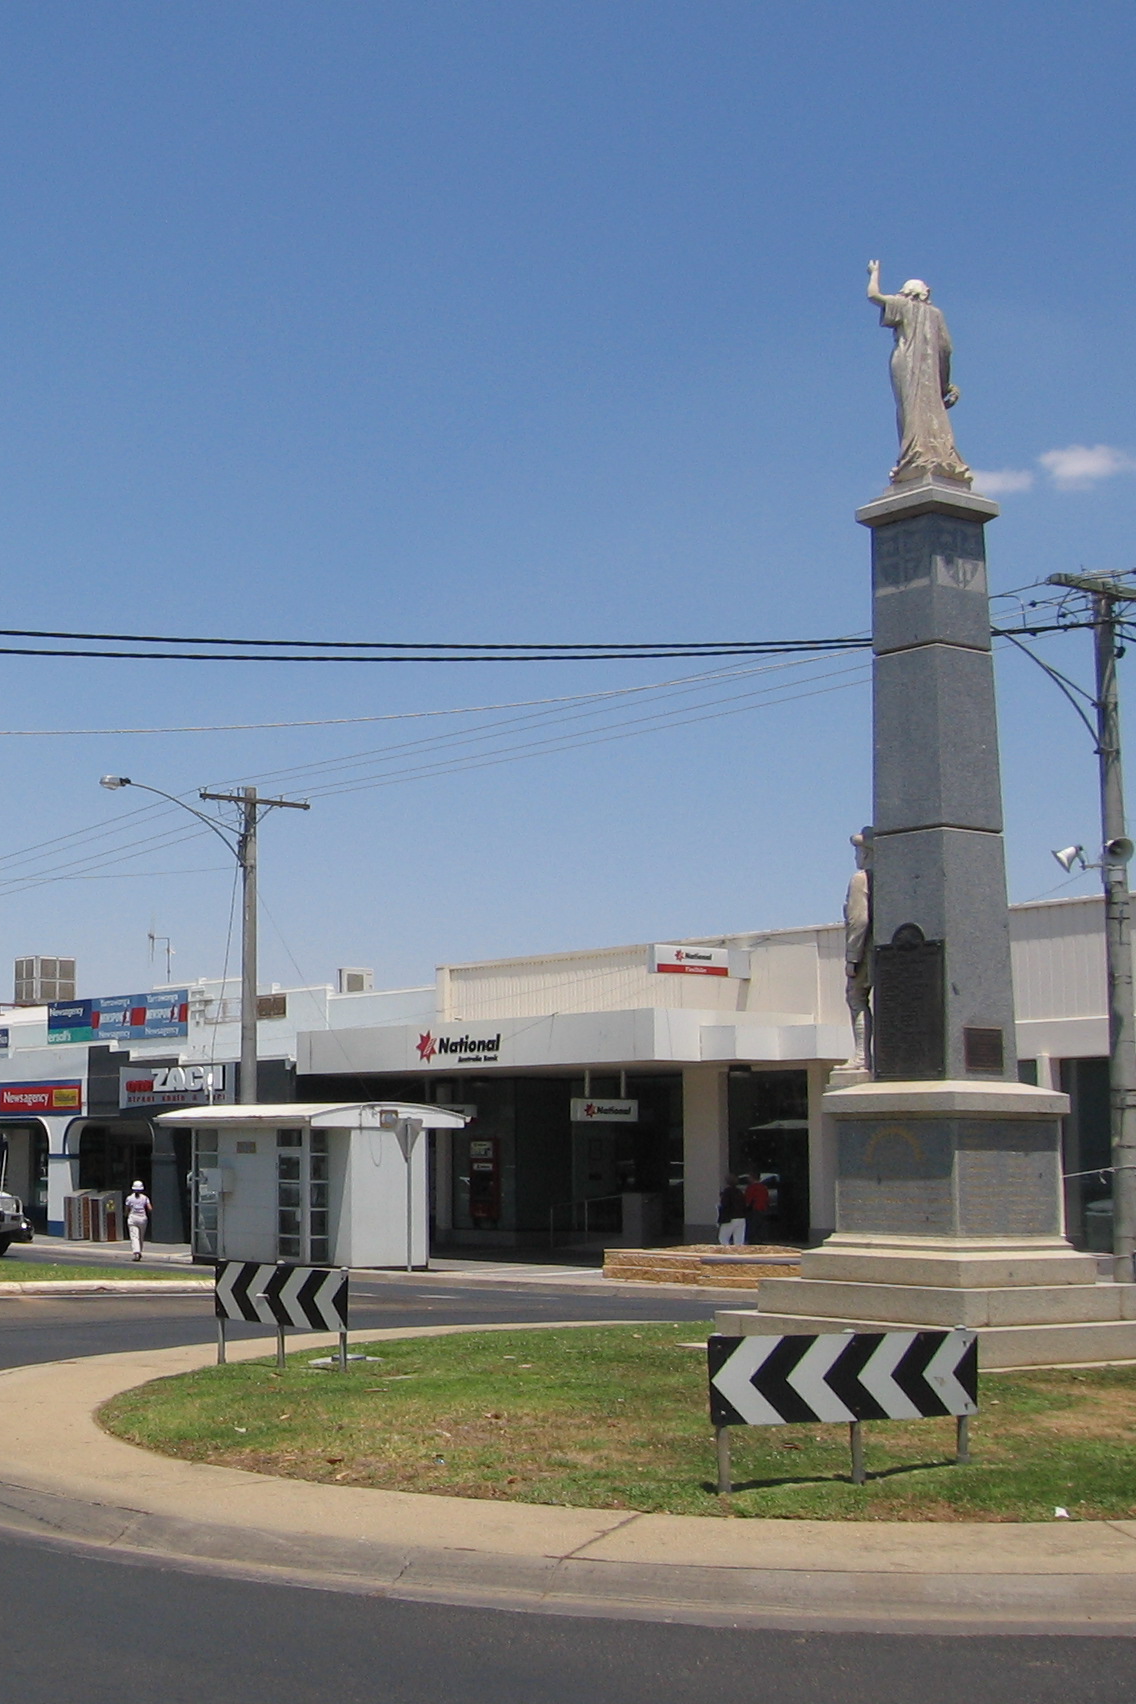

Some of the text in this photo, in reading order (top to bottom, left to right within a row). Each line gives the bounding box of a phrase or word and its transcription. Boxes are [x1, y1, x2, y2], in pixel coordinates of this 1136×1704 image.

[50, 1007, 84, 1017] Newsagency
[98, 1030, 130, 1039] Newsagency
[145, 1027, 179, 1036] Newsagency
[438, 1034, 501, 1054] National
[3, 1092, 49, 1107] Newsagency
[597, 1106, 632, 1115] National
